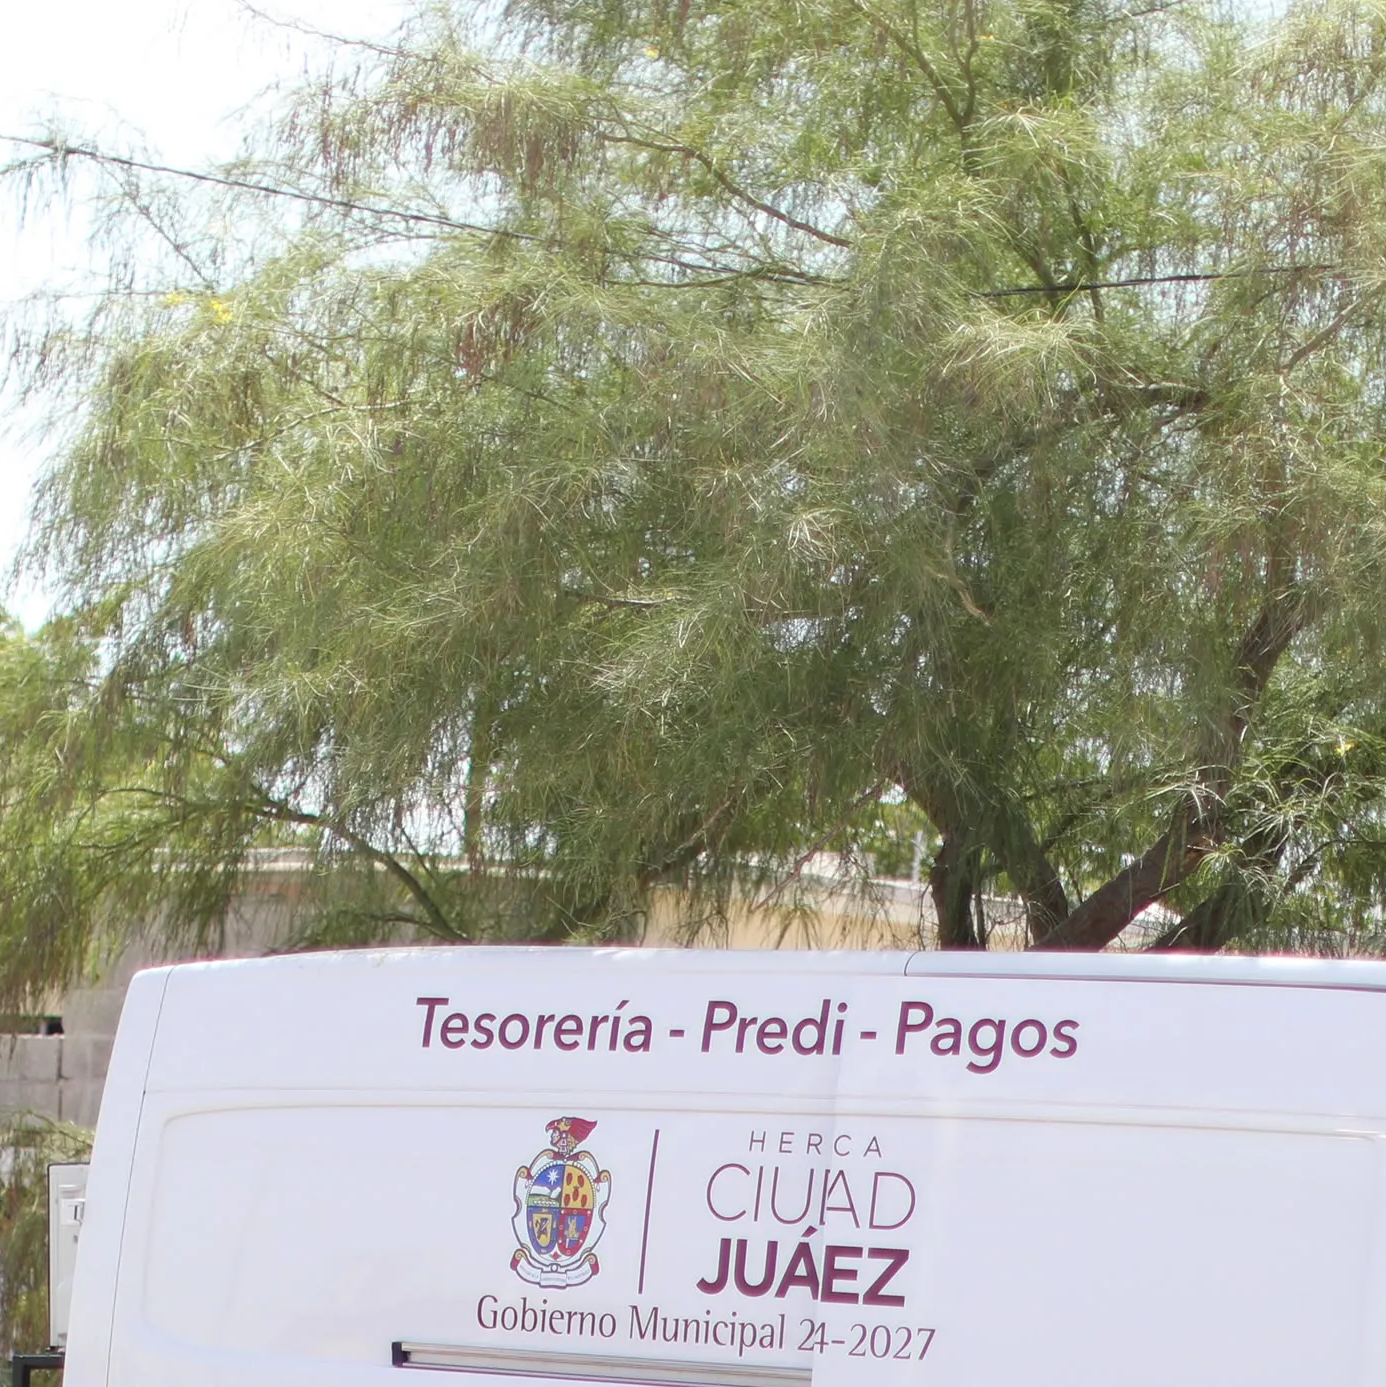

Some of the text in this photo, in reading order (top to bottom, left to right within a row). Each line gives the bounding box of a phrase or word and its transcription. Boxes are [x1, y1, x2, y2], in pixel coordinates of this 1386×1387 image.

[416, 997, 652, 1052] Tesorería
[701, 999, 847, 1055] Predi
[895, 1001, 1080, 1074] Pagos
[477, 1295, 616, 1338] Gobierno
[628, 1304, 785, 1357] Municipal
